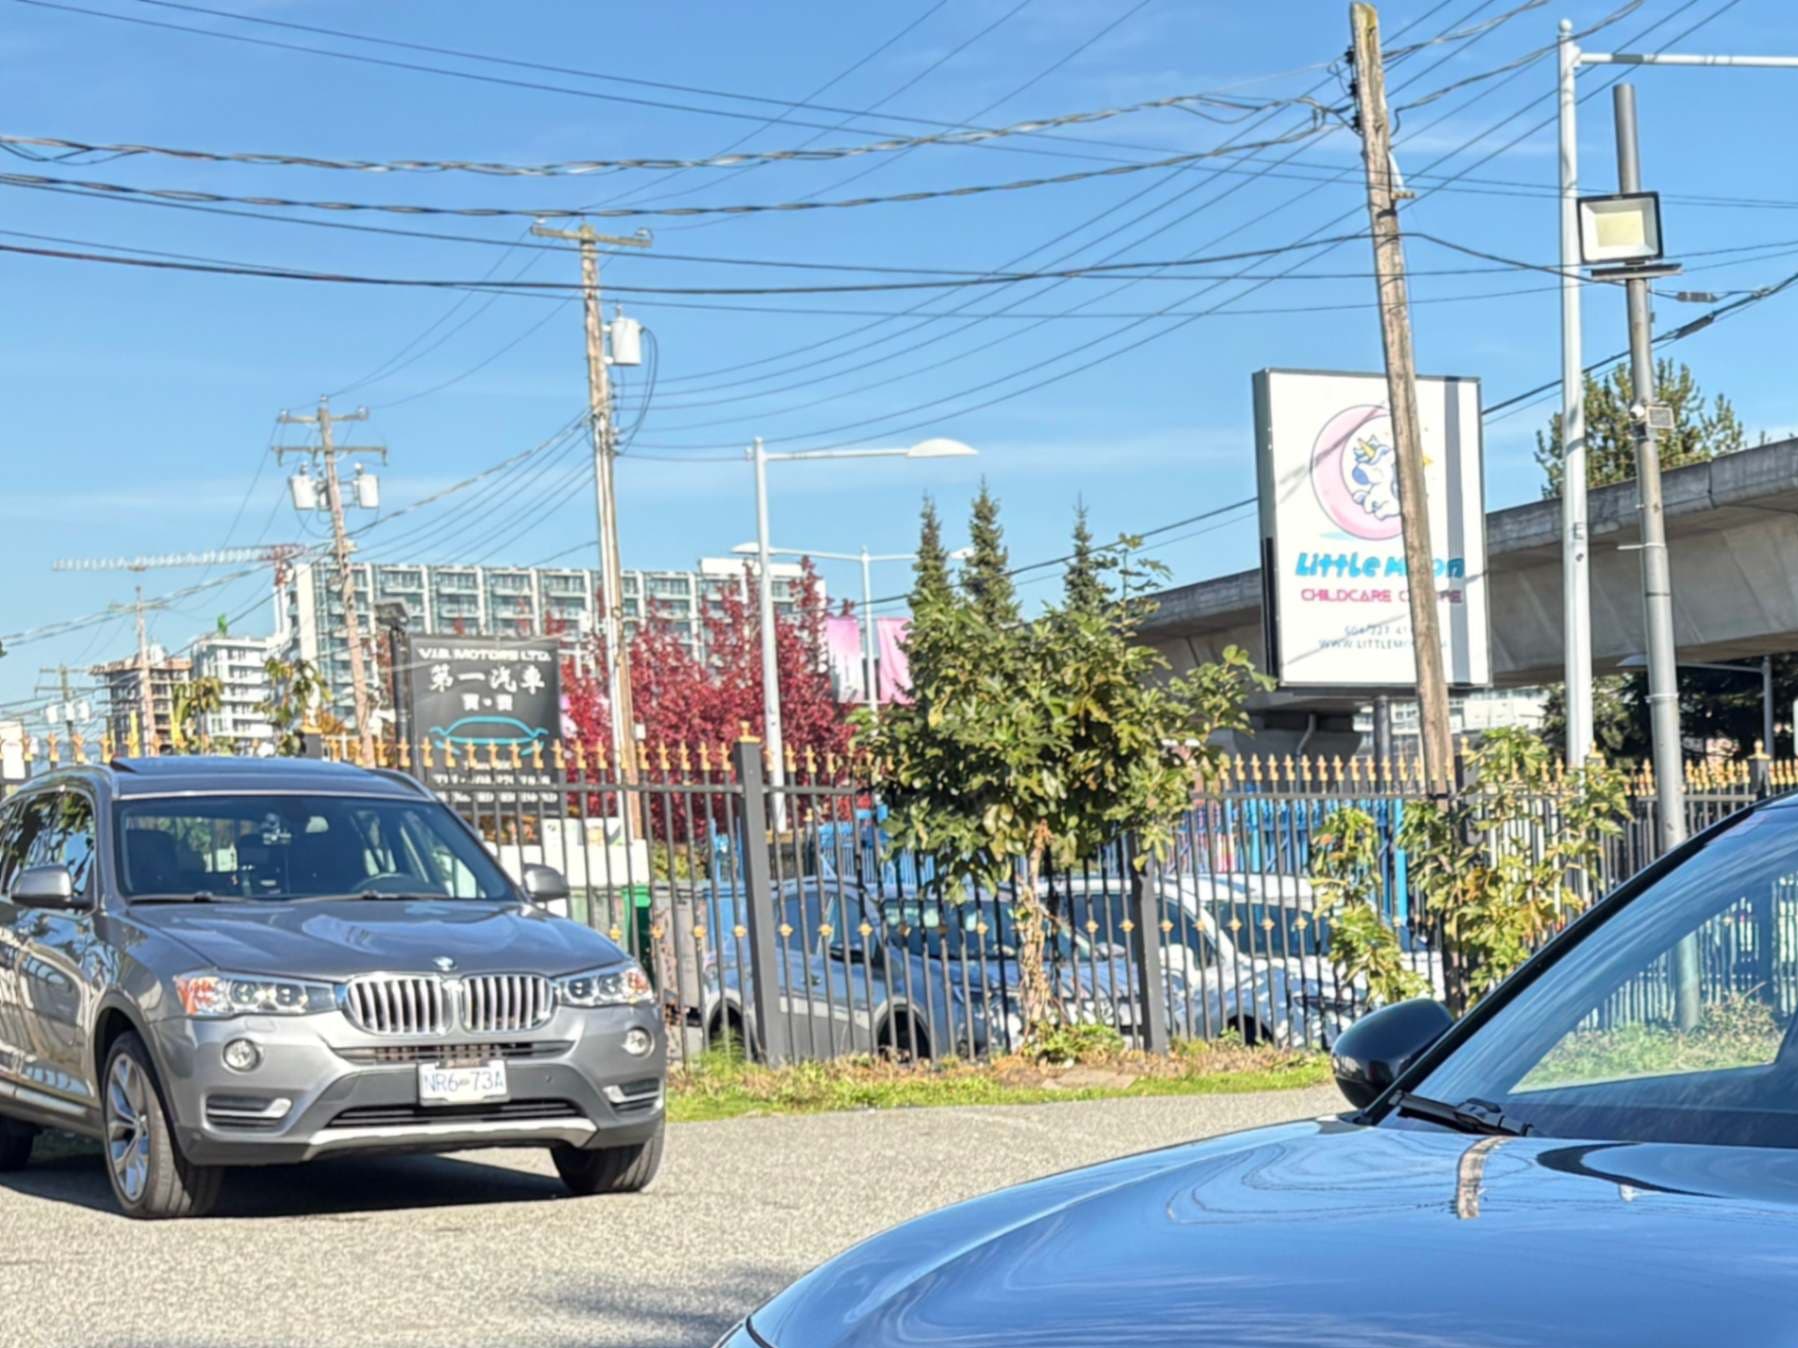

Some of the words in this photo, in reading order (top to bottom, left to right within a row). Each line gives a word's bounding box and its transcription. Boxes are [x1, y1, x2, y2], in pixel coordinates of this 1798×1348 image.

[1385, 556, 1465, 578] Mon
[1301, 588, 1392, 602] CHILDCARE
[430, 663, 545, 694] 第一汽車
